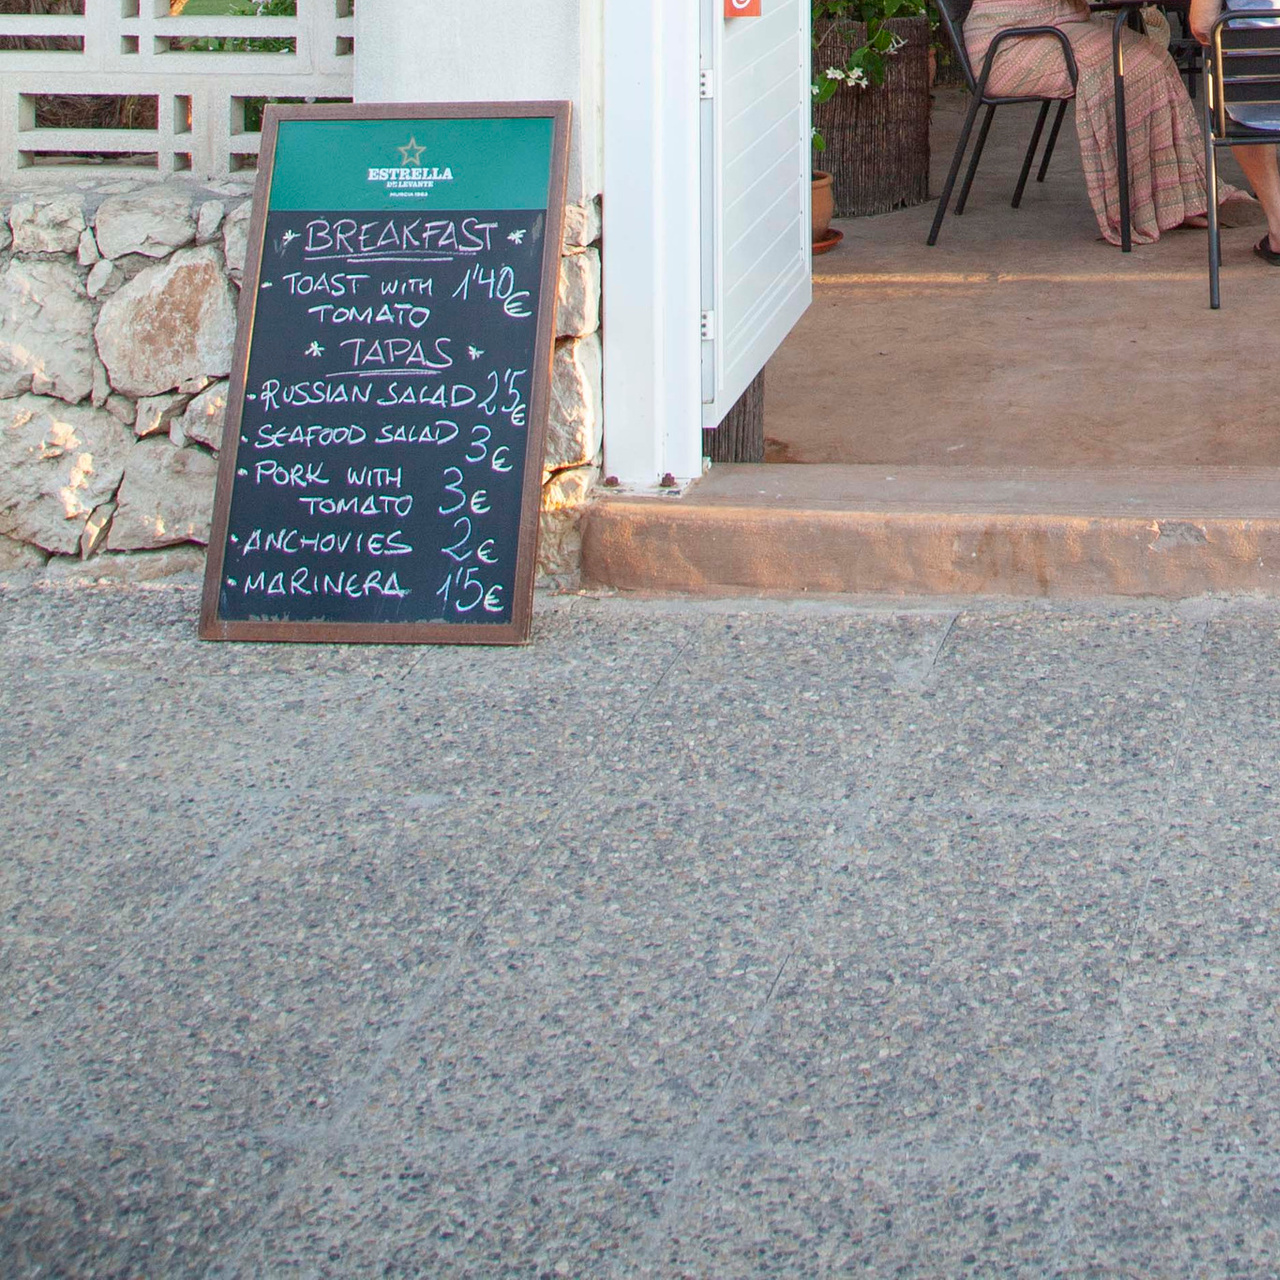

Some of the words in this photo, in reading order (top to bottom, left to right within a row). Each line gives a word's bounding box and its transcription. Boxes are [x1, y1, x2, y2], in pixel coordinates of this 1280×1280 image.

[367, 167, 454, 181] ESTRELLA
[386, 180, 397, 188] DE
[398, 180, 434, 189] LEVANTE
[304, 217, 499, 253] BREAKFAST
[283, 272, 371, 297] TOAST
[381, 277, 433, 296] WITH
[307, 303, 431, 328] TOMATO
[339, 337, 453, 369] TAPAS
[260, 378, 373, 412] RUSSIAN
[376, 381, 477, 409] SALAD
[254, 423, 367, 449] SEAFOOD
[374, 420, 459, 446] SALAD
[255, 459, 330, 487] PORK
[347, 466, 402, 488] WITH
[299, 494, 414, 517] TOMATO
[242, 527, 414, 557] ANCHOVIES
[244, 566, 408, 599] MARINERA
